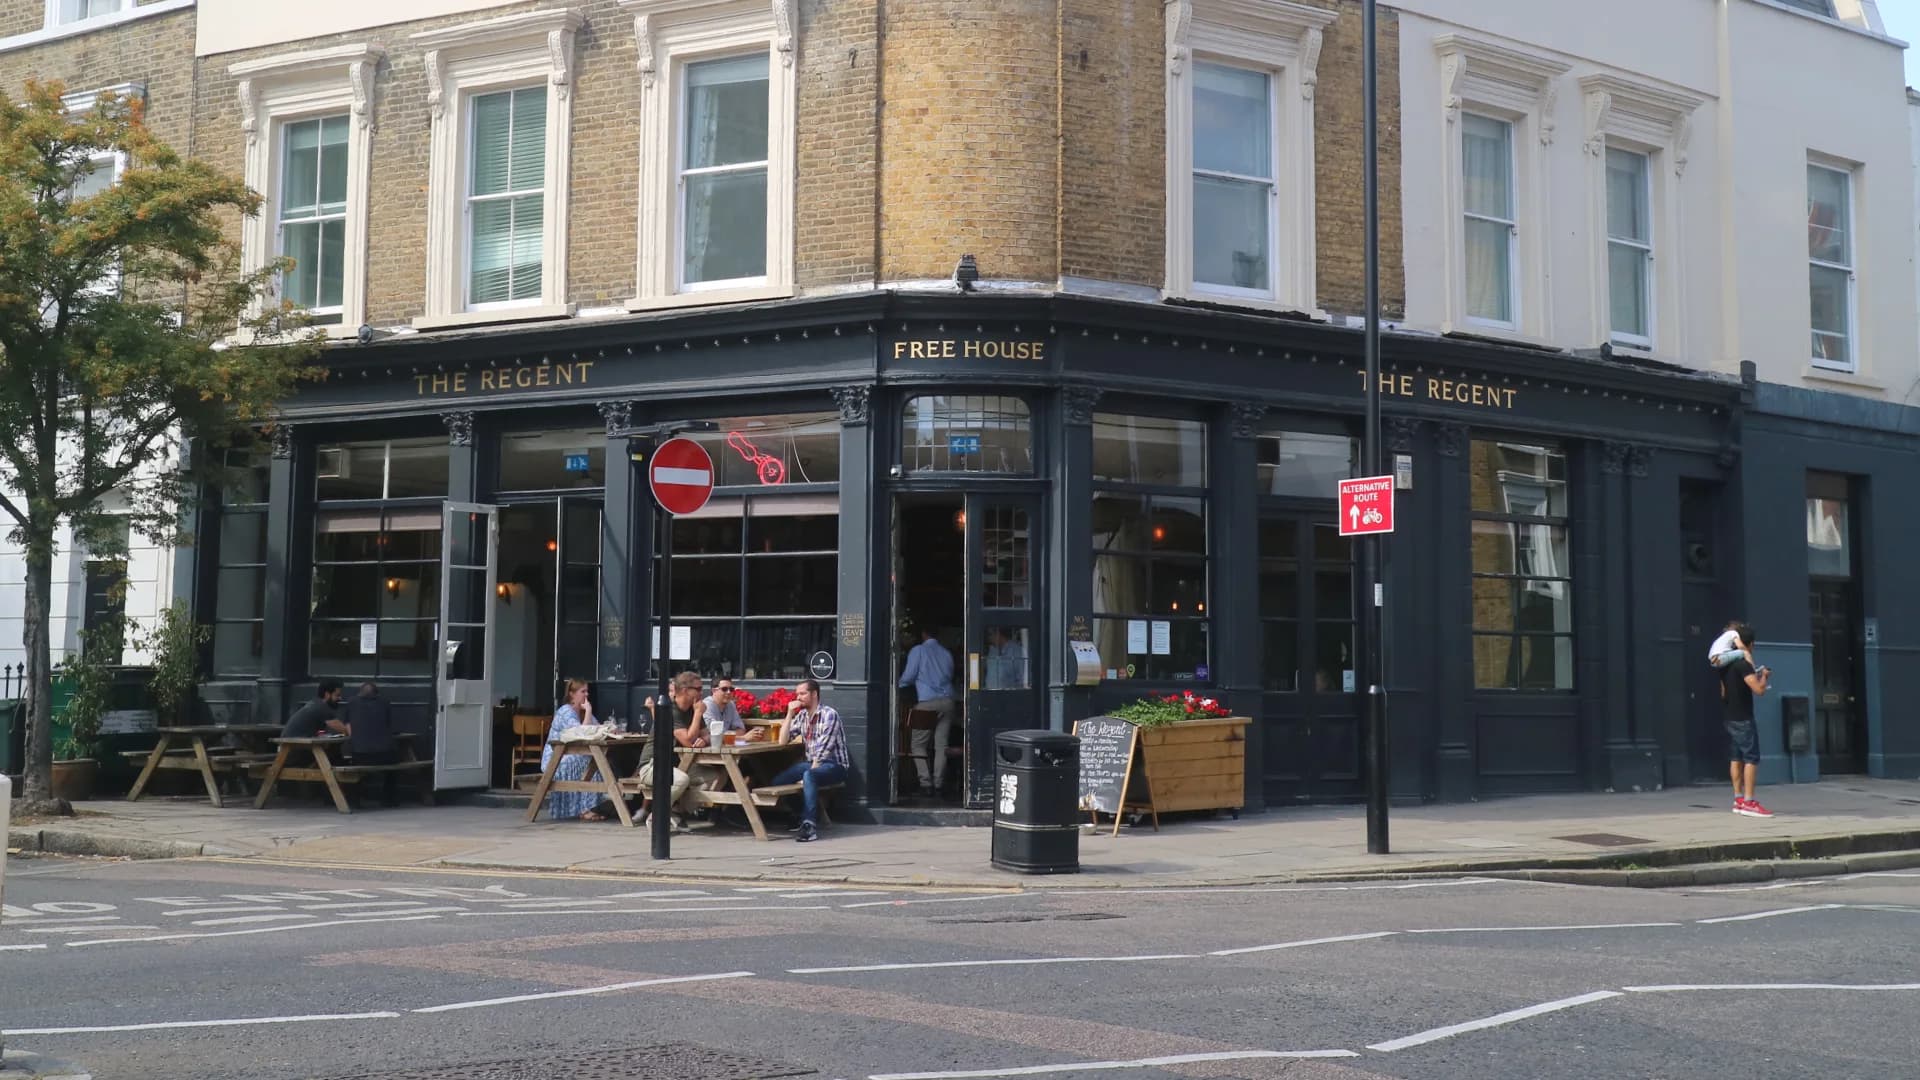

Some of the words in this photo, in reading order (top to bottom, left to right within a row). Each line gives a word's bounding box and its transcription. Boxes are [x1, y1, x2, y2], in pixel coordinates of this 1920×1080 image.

[894, 340, 957, 359] FREE
[963, 340, 1044, 360] HOUSE
[414, 371, 467, 395] THE
[480, 362, 594, 390] REGENT
[1357, 370, 1414, 397] THE
[1427, 378, 1517, 409] REGENT
[1342, 481, 1390, 494] ALTERNATIVE
[1353, 492, 1379, 503] ROUTE
[1081, 721, 1097, 735] The
[1098, 721, 1127, 738] Regent
[133, 885, 528, 906] ENTRY
